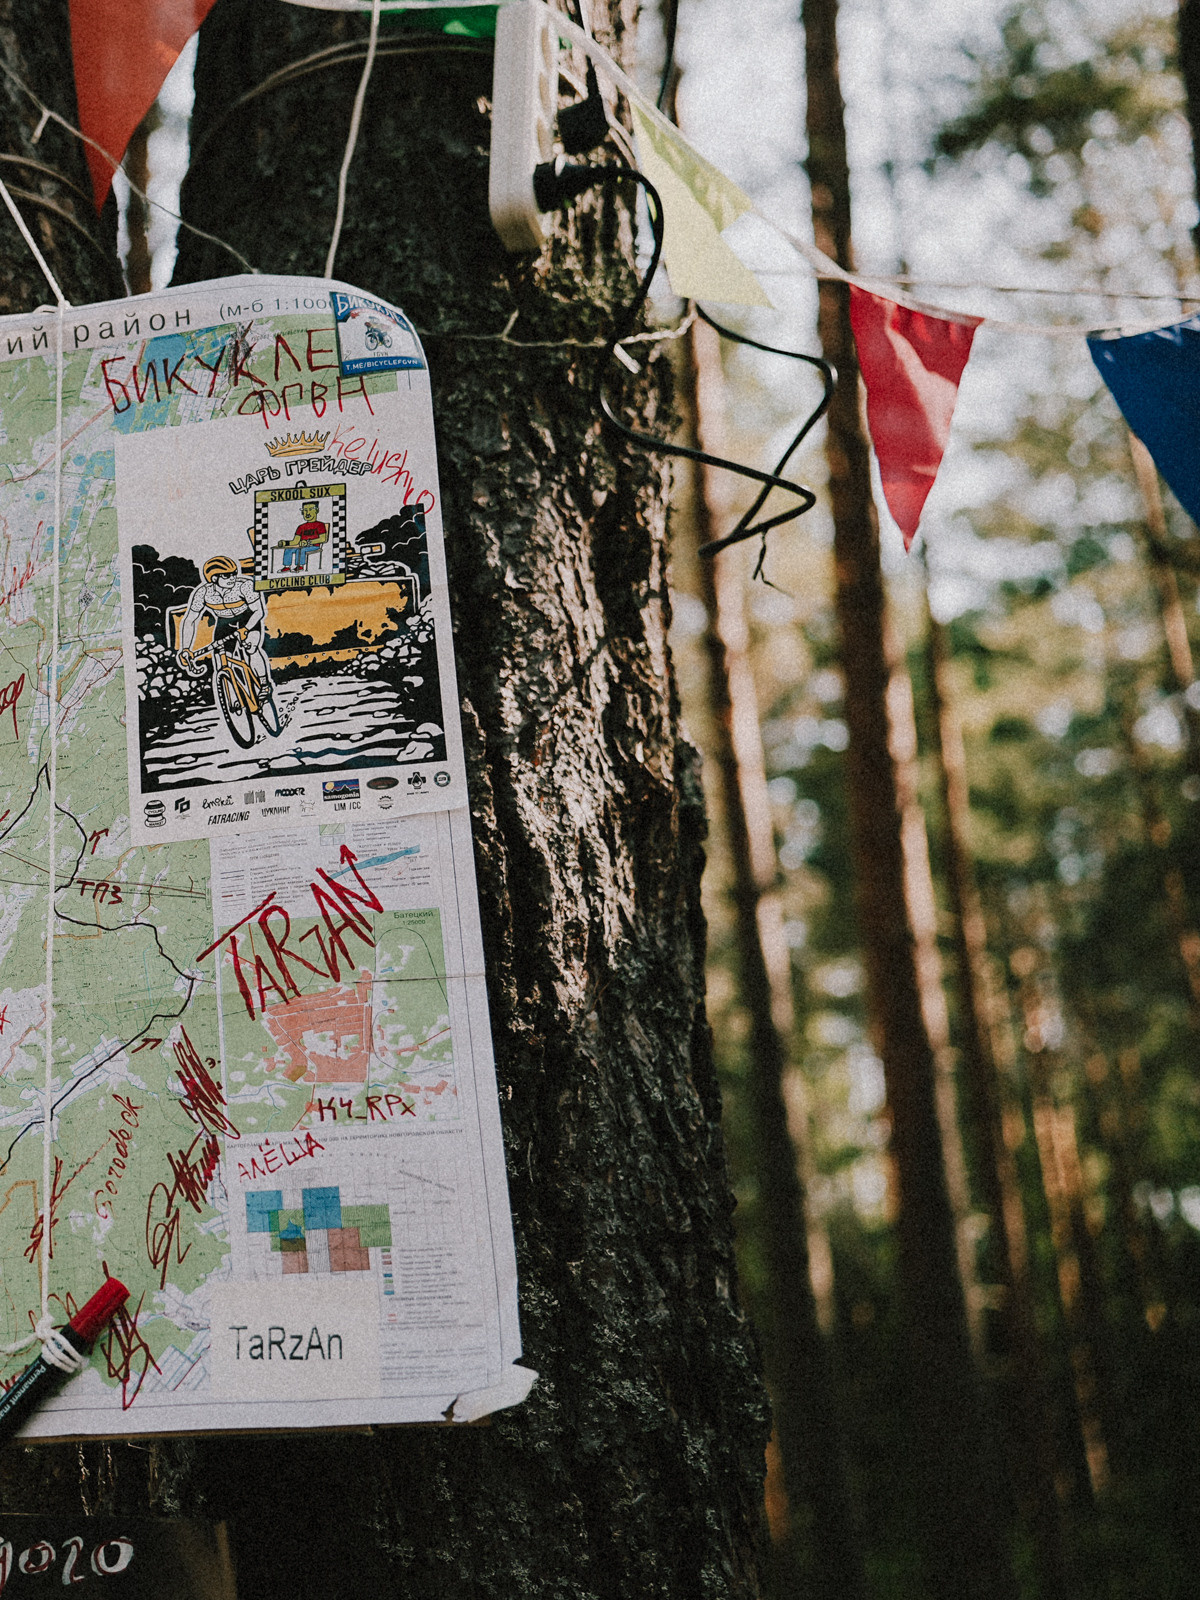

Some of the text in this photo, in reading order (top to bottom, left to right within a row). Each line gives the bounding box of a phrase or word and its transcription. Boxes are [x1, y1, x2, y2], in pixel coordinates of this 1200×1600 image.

[73, 308, 191, 348] район
[219, 299, 263, 322] (м-б
[229, 455, 373, 495] ЦАРЬ ГРЕЙДЕР
[270, 486, 331, 502] SKOOL SUX
[269, 573, 331, 589] CYCLING CLUB
[207, 810, 250, 826] FATRACING
[393, 910, 434, 920] Батецкий
[228, 1325, 342, 1361] TaRzAn
[9, 1363, 47, 1406] Permanent
